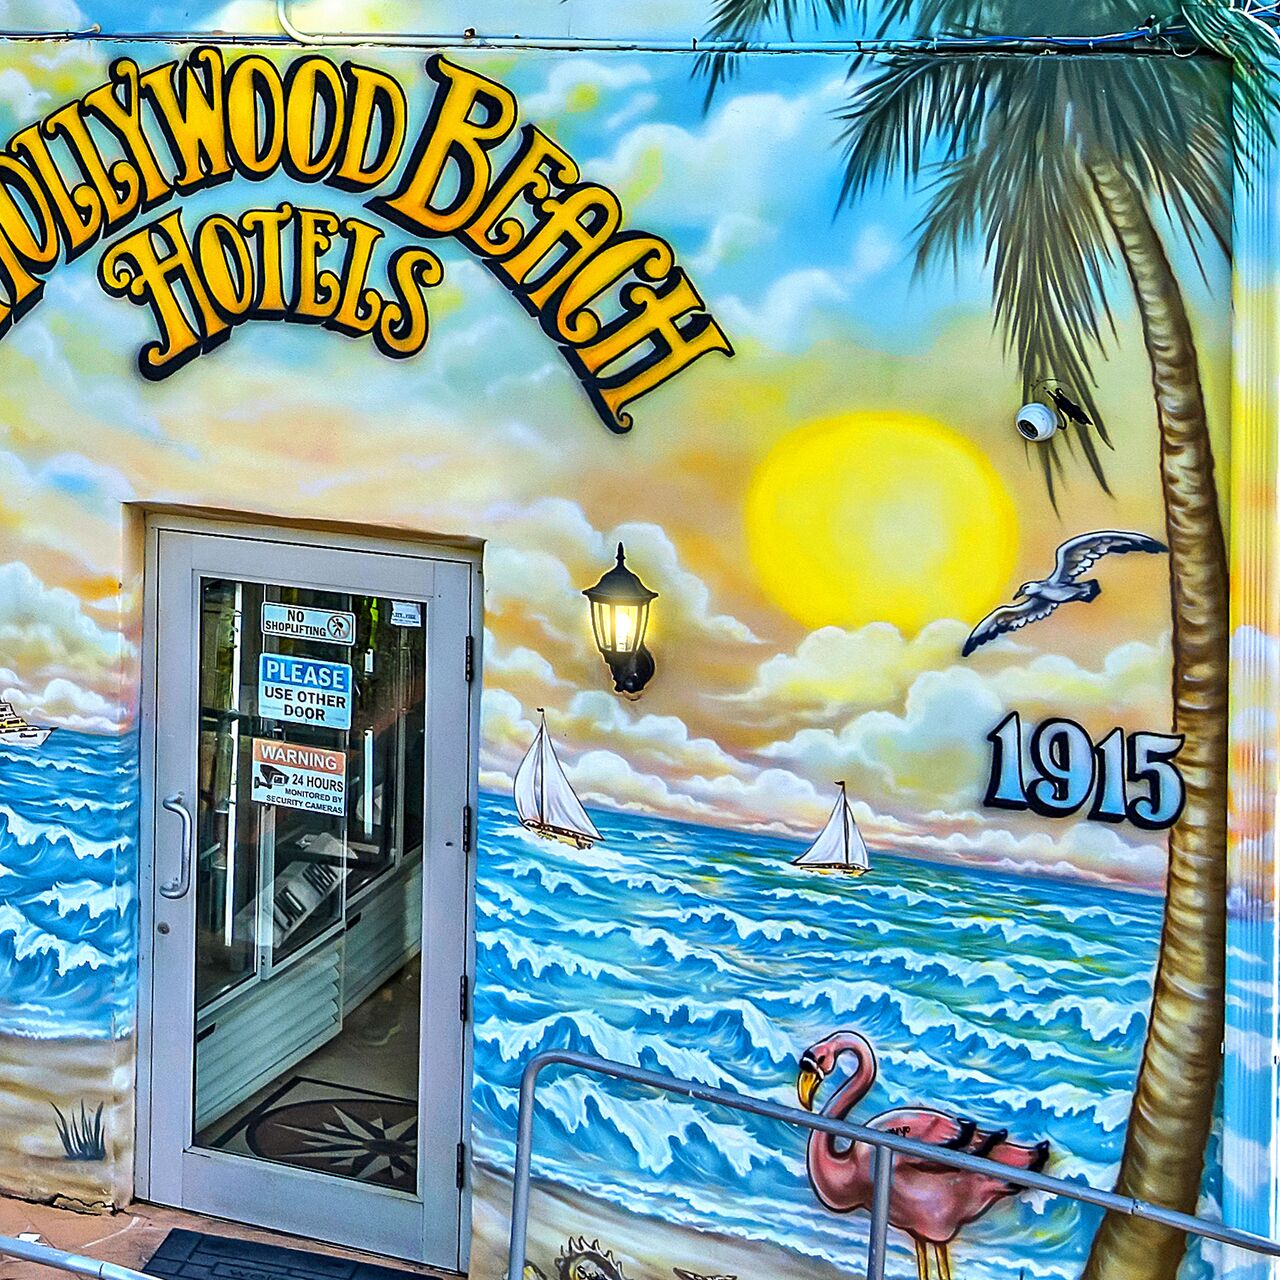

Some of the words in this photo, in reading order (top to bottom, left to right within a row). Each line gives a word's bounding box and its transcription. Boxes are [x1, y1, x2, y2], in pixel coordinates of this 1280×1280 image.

[365, 53, 736, 435] BEACH
[100, 202, 444, 382] HOTELS
[287, 609, 305, 623] NO
[265, 620, 327, 637] SHOPLIFTING
[266, 660, 344, 689] PLEASE
[265, 685, 293, 701] USE
[297, 691, 346, 709] OTHER
[284, 704, 325, 721] DOOR
[261, 744, 337, 771] WARNING
[983, 711, 1186, 830] 1915
[292, 773, 304, 786] 24
[306, 776, 344, 793] HOURS
[266, 794, 304, 807] SECURITY
[304, 801, 343, 815] CAMERAS
[285, 787, 331, 802] MONITORED
[331, 795, 343, 804] BY
